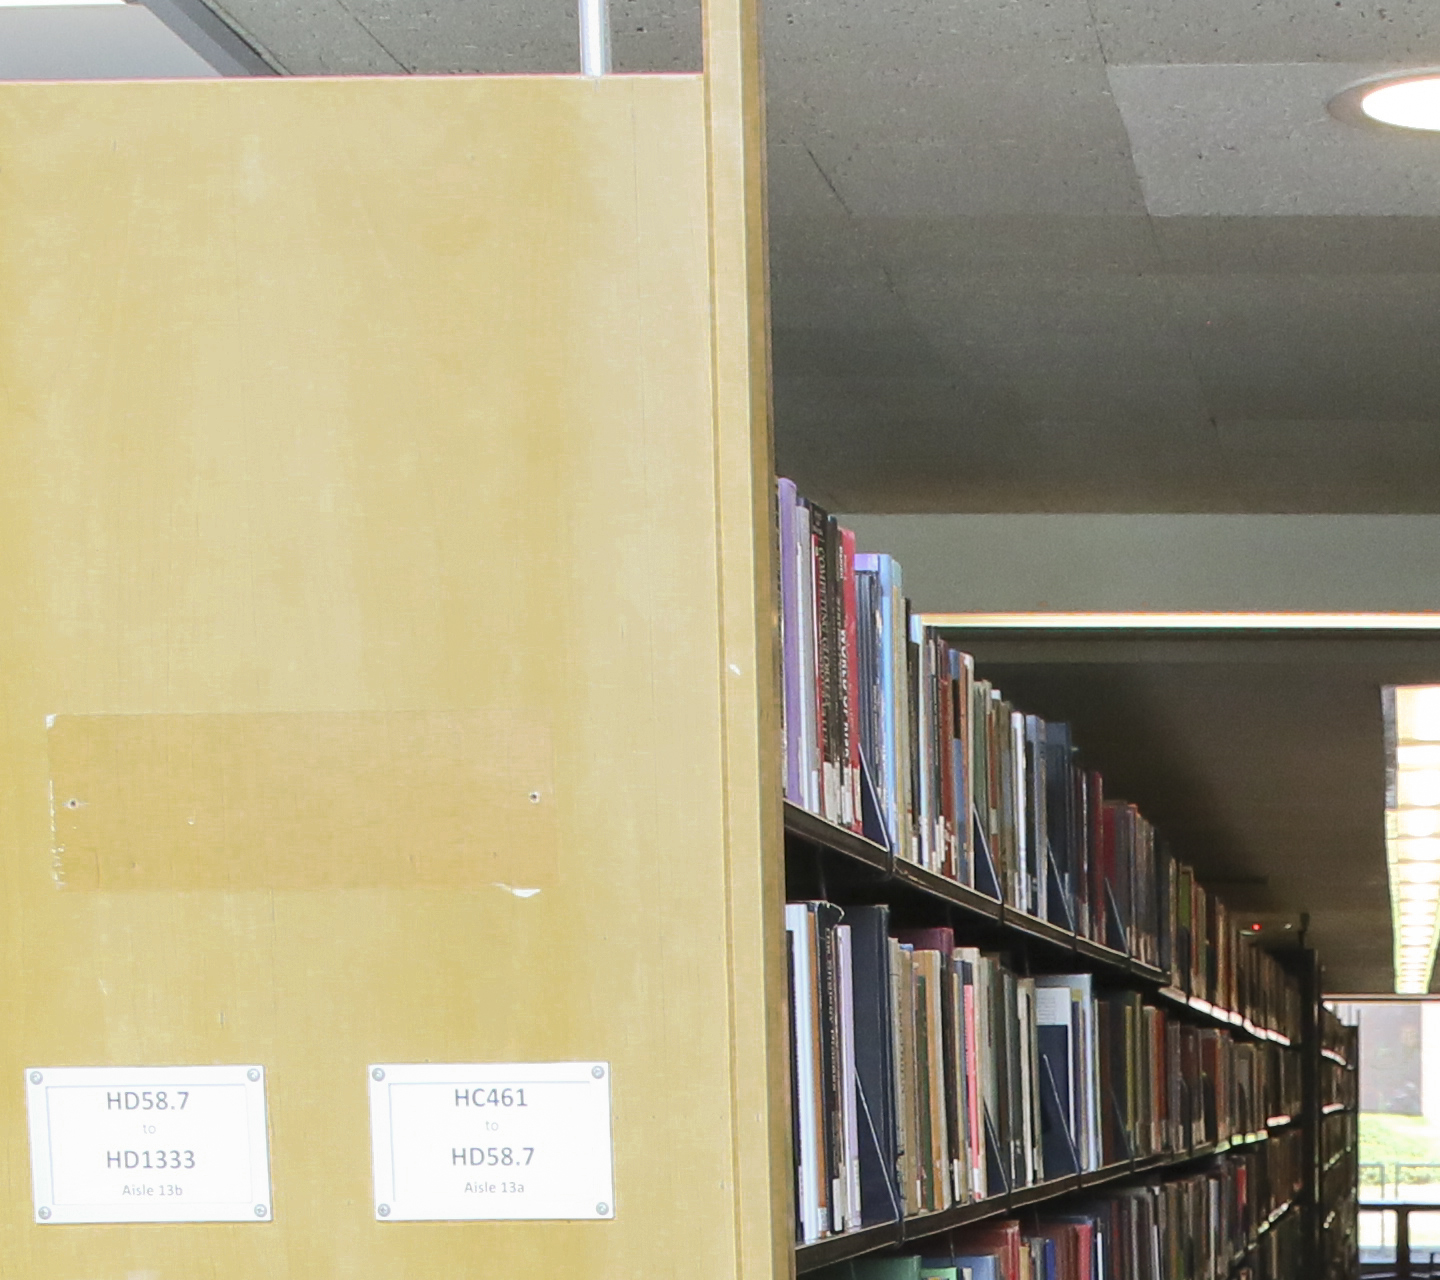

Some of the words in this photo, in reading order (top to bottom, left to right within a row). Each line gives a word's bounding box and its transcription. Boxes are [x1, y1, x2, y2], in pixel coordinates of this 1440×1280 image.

[107, 1091, 189, 1110] HD58.7
[455, 1088, 527, 1107] HC461
[142, 1124, 157, 1135] to
[485, 1120, 499, 1132] to
[107, 1150, 195, 1169] HD1333
[452, 1147, 534, 1166] HD58.7
[122, 1184, 154, 1196] Aisle
[159, 1184, 183, 1196] 13b
[464, 1182, 496, 1194] Aisle
[501, 1181, 525, 1193] 13a
